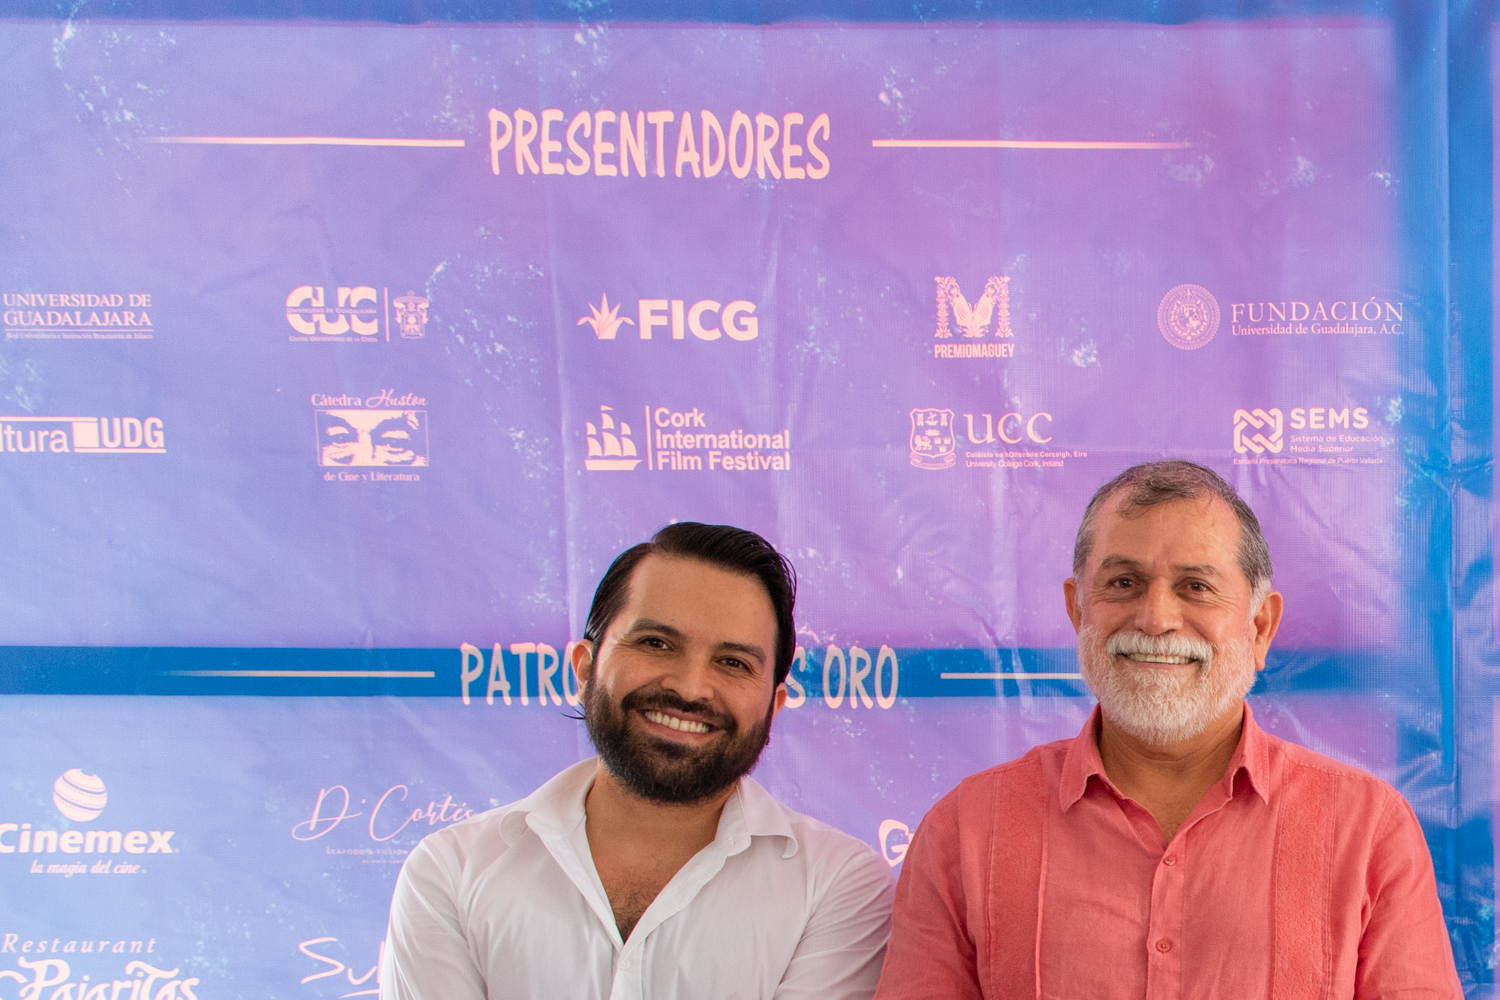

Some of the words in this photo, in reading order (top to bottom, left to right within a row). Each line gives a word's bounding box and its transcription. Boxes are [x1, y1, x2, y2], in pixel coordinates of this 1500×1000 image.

[488, 107, 830, 180] PRESENTADORES
[3, 293, 123, 307] UNIVERSIDAD
[129, 293, 152, 307] DE
[286, 285, 379, 335] CUC
[1231, 296, 1404, 322] FUNDACIÓN
[3, 310, 153, 326] GUADALAJARA
[639, 299, 759, 341] FICG
[1232, 323, 1293, 336] Universidad
[1295, 323, 1308, 335] de
[1311, 322, 1377, 337] Guadalajara,
[1380, 324, 1404, 335] A.C.
[934, 343, 1015, 358] PREMIOMAGUEY
[311, 393, 362, 406] Cátedra
[365, 388, 428, 408] Huston
[654, 407, 706, 428] Cork
[1290, 407, 1369, 429] SEMS
[100, 417, 165, 448] UDG
[655, 429, 790, 449] International
[1290, 434, 1324, 443] Sistema
[1326, 434, 1337, 443] de
[1339, 434, 1384, 443] Educación
[1290, 445, 1316, 453] Media
[1318, 445, 1354, 454] Superior
[657, 450, 702, 470] Film
[708, 450, 790, 471] Festival
[323, 471, 336, 481] de
[338, 471, 360, 481] Cine
[370, 471, 420, 481] Literatura
[822, 644, 899, 709] ORO
[0, 823, 175, 854] Cinemex
[29, 860, 44, 874] la
[46, 861, 88, 878] magia
[90, 860, 112, 874] del
[113, 861, 141, 874] cine
[1, 933, 157, 953] Restaurant
